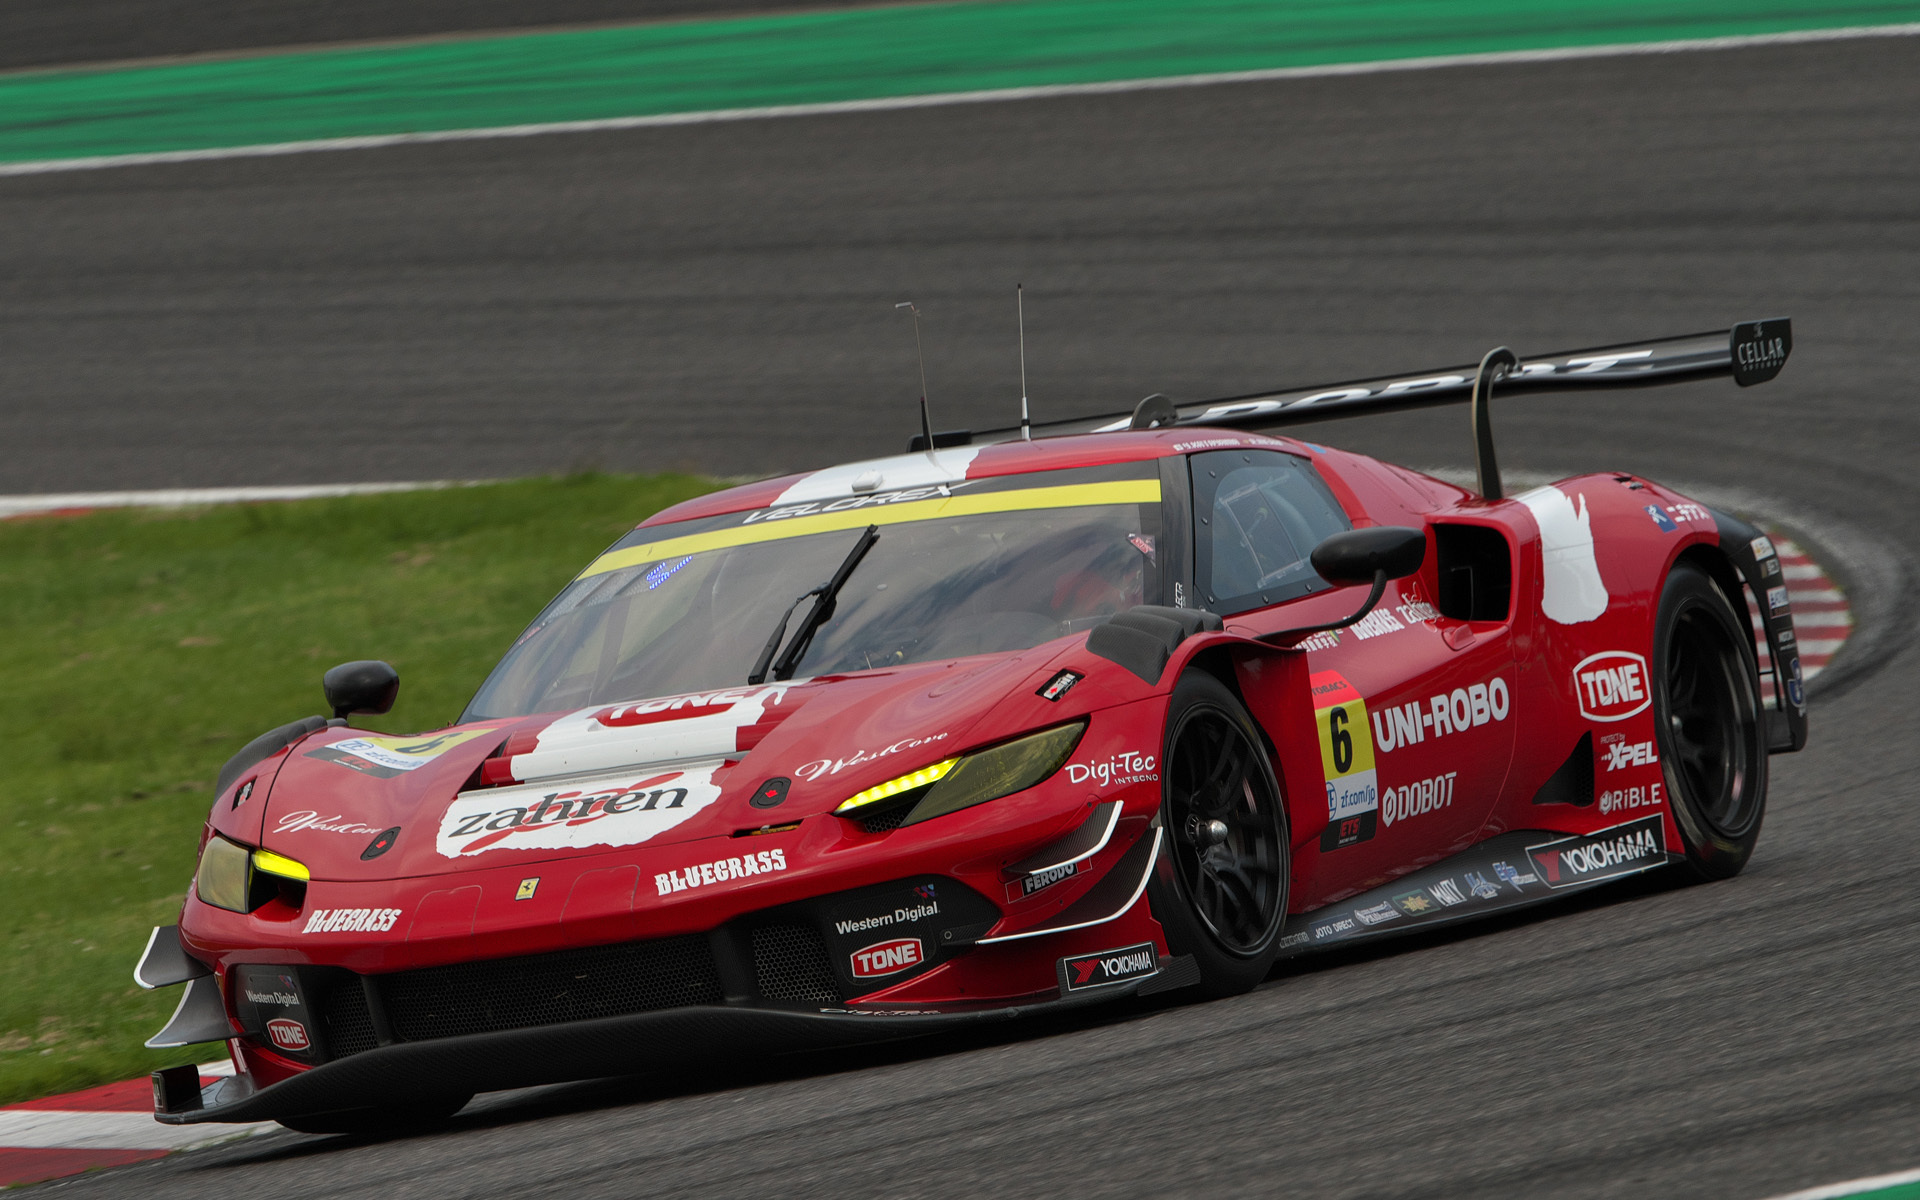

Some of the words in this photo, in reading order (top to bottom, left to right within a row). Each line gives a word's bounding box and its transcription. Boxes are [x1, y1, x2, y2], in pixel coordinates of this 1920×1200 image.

[1738, 337, 1785, 365] CELLAR
[742, 481, 977, 524] VELOREX
[1580, 663, 1644, 709] TONE
[610, 687, 754, 720] TONE
[1372, 677, 1510, 753] UNI-ROBO
[1330, 706, 1353, 773] 6
[795, 732, 948, 781] WestCove
[1064, 750, 1156, 787] Digi-Tec
[1607, 741, 1658, 772] XPEL
[1114, 773, 1159, 785] INTECNO
[1341, 784, 1376, 808] zf.com/jp
[1397, 771, 1457, 821] DOBOT
[1613, 783, 1662, 811] RiBLE
[448, 787, 688, 838] zahren
[1341, 818, 1360, 837] ETS
[1560, 829, 1658, 875] YOKOHAMA
[654, 848, 787, 896] BLUEGRASS
[1025, 863, 1075, 893] FERODO
[302, 908, 403, 934] BLUEGRASS
[835, 914, 893, 935] Western
[895, 901, 939, 922] Digital
[1315, 925, 1333, 939] JOTO
[1333, 918, 1355, 933] DIRECT
[857, 943, 918, 973] TONE
[1100, 951, 1153, 977] YOKOHAMA
[245, 989, 275, 1004] Western
[273, 992, 300, 1007] Digital
[271, 1025, 306, 1044] TONE
